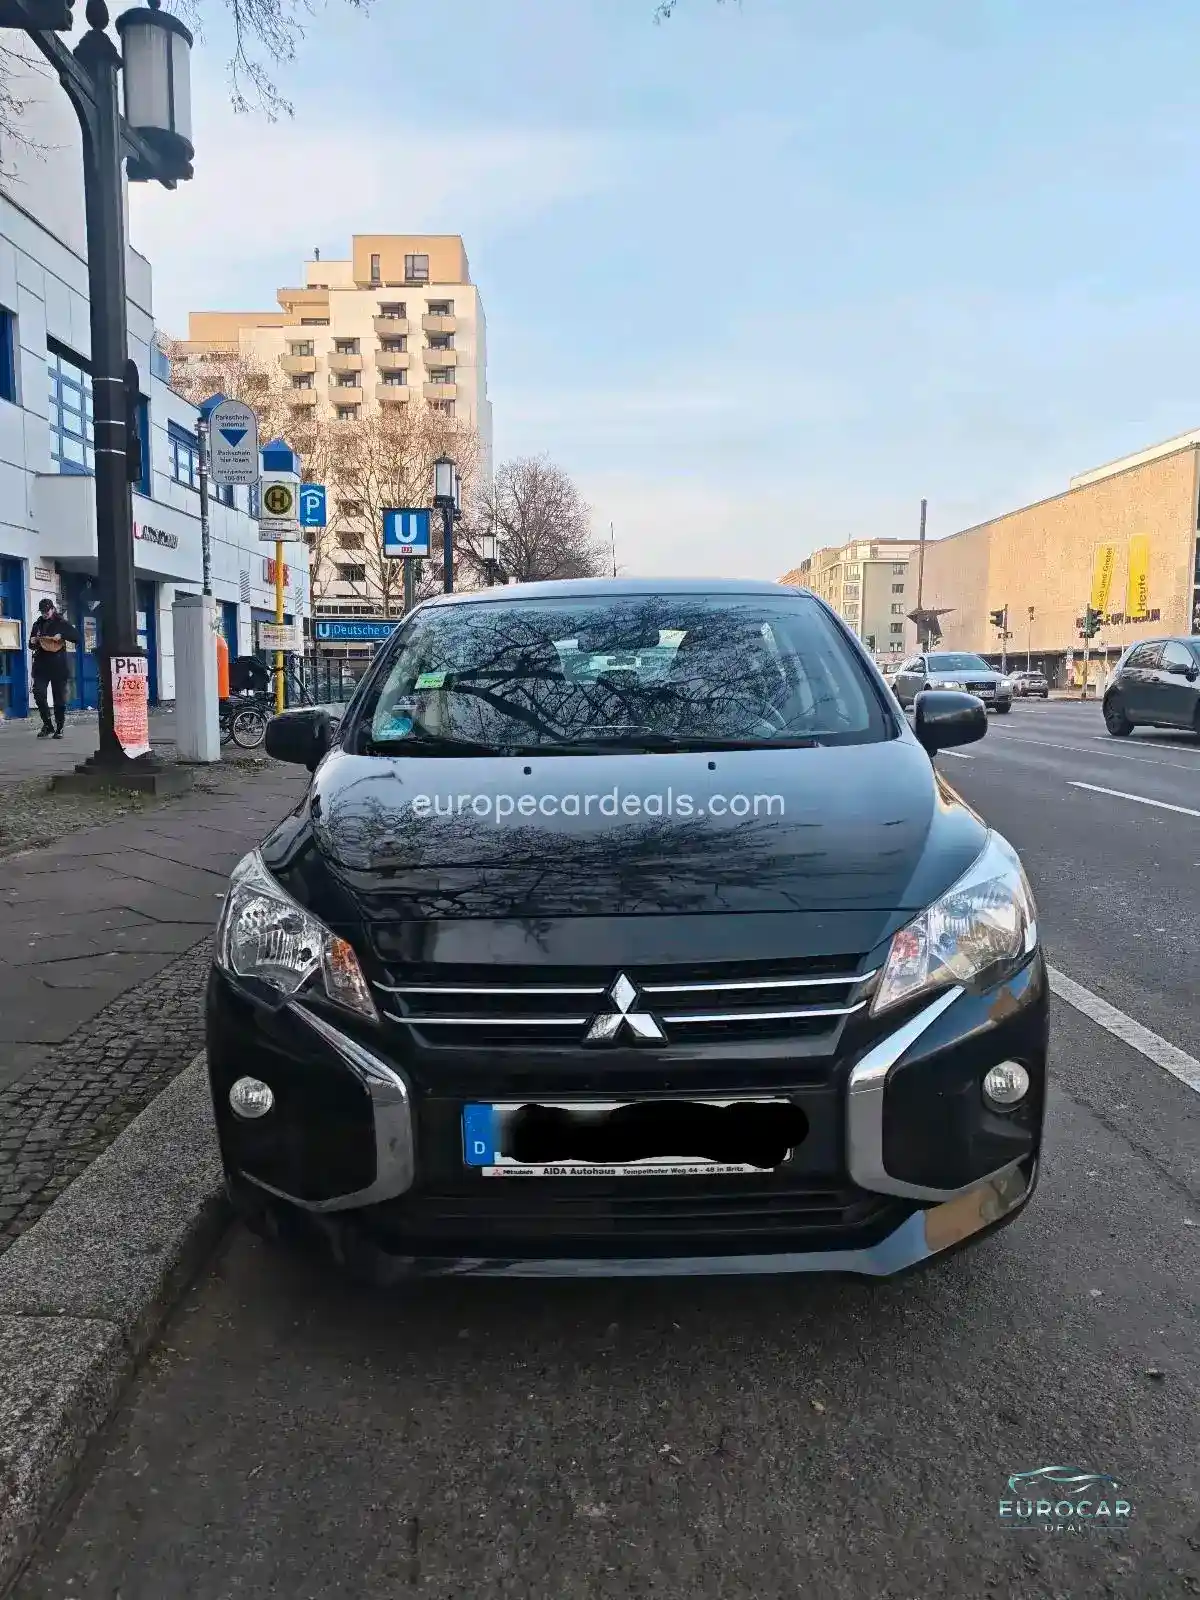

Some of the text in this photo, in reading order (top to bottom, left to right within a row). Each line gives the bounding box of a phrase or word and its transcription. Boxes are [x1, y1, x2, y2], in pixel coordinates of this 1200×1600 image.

[271, 492, 286, 508] H
[307, 496, 320, 514] P
[395, 514, 417, 543] U
[1137, 574, 1147, 612] Heute
[319, 624, 330, 637] U
[333, 624, 379, 635] Deutsche
[474, 1142, 486, 1155] D
[543, 1167, 566, 1175] AIDA
[570, 1166, 616, 1175] Autohaus
[623, 1167, 668, 1176] Tempelhofer
[671, 1167, 686, 1175] Weg
